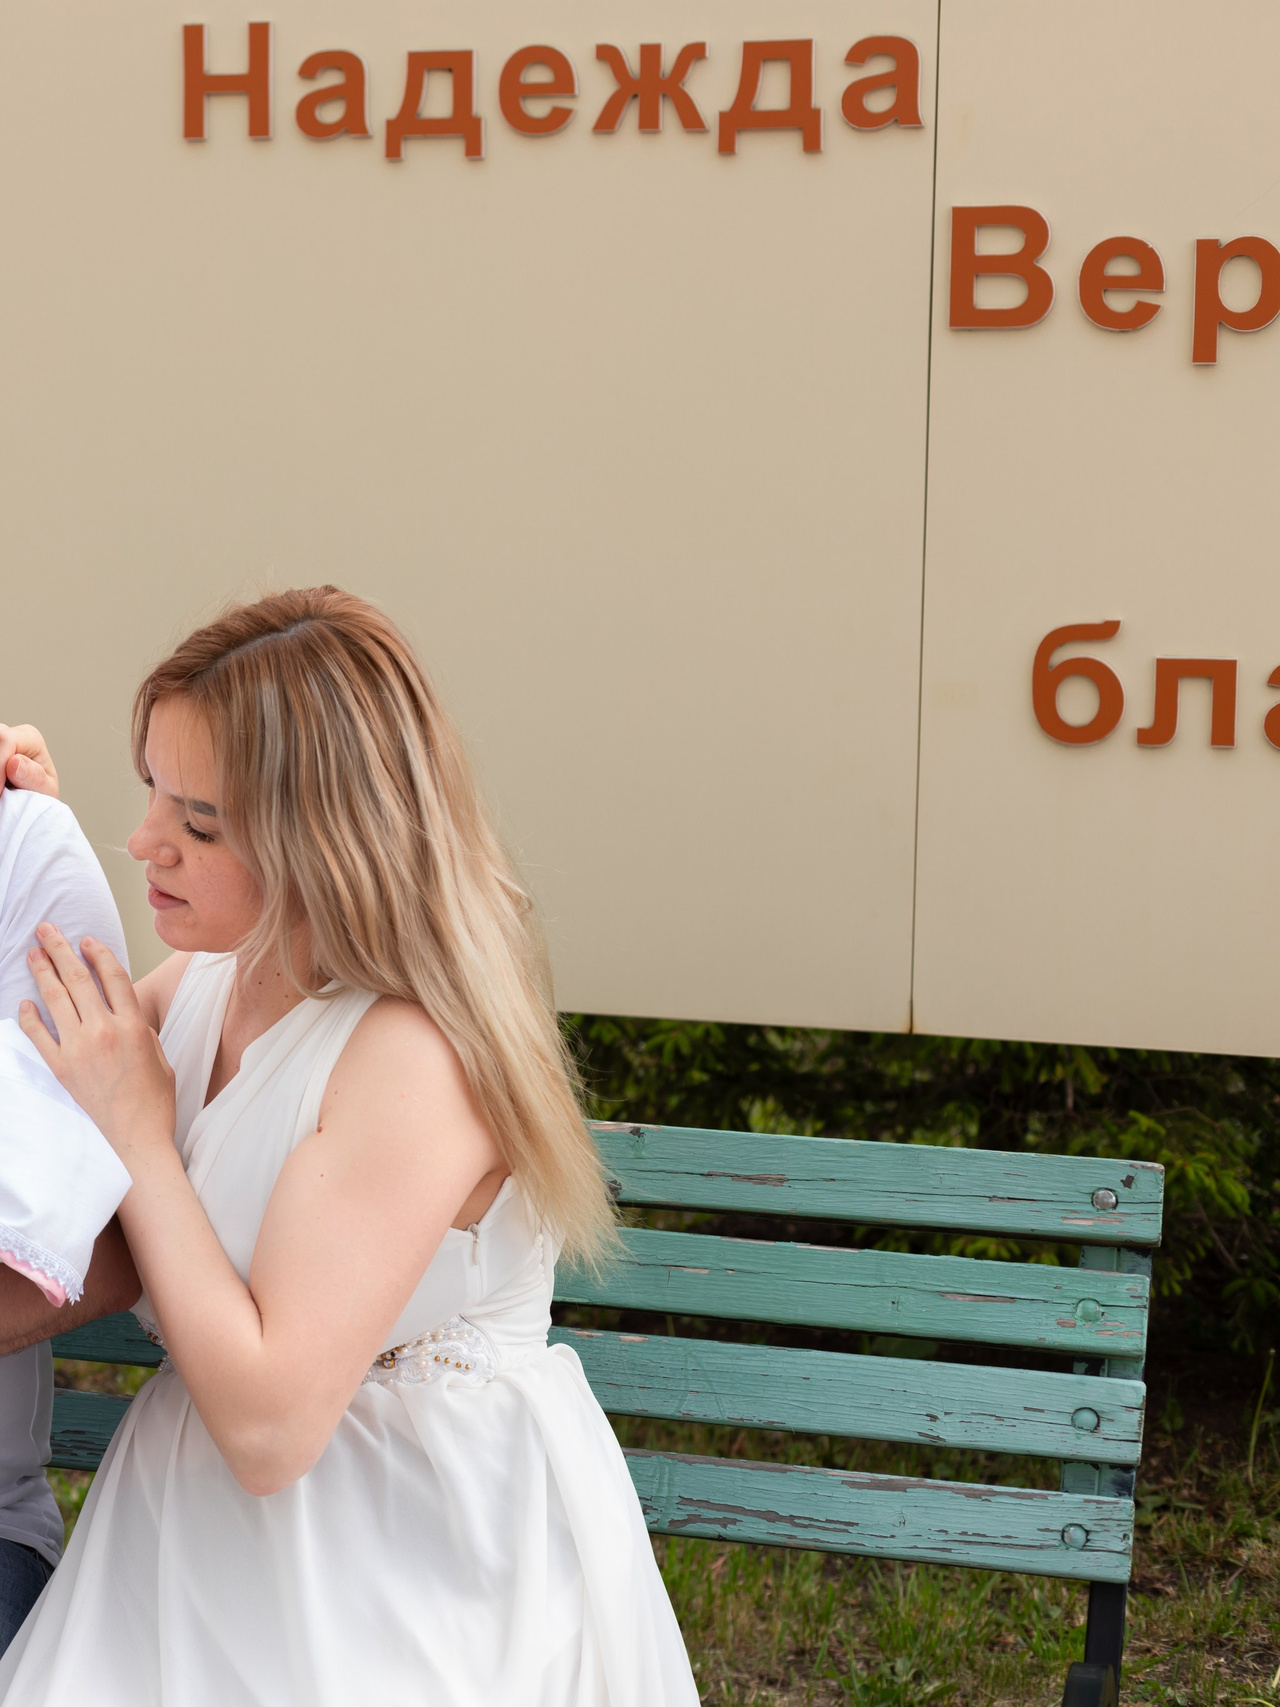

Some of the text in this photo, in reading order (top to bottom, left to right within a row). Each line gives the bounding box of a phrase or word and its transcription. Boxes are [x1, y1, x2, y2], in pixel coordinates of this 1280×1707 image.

[182, 21, 924, 161] Надежда
[948, 204, 1280, 365] Вер
[1031, 619, 1280, 749] бл
